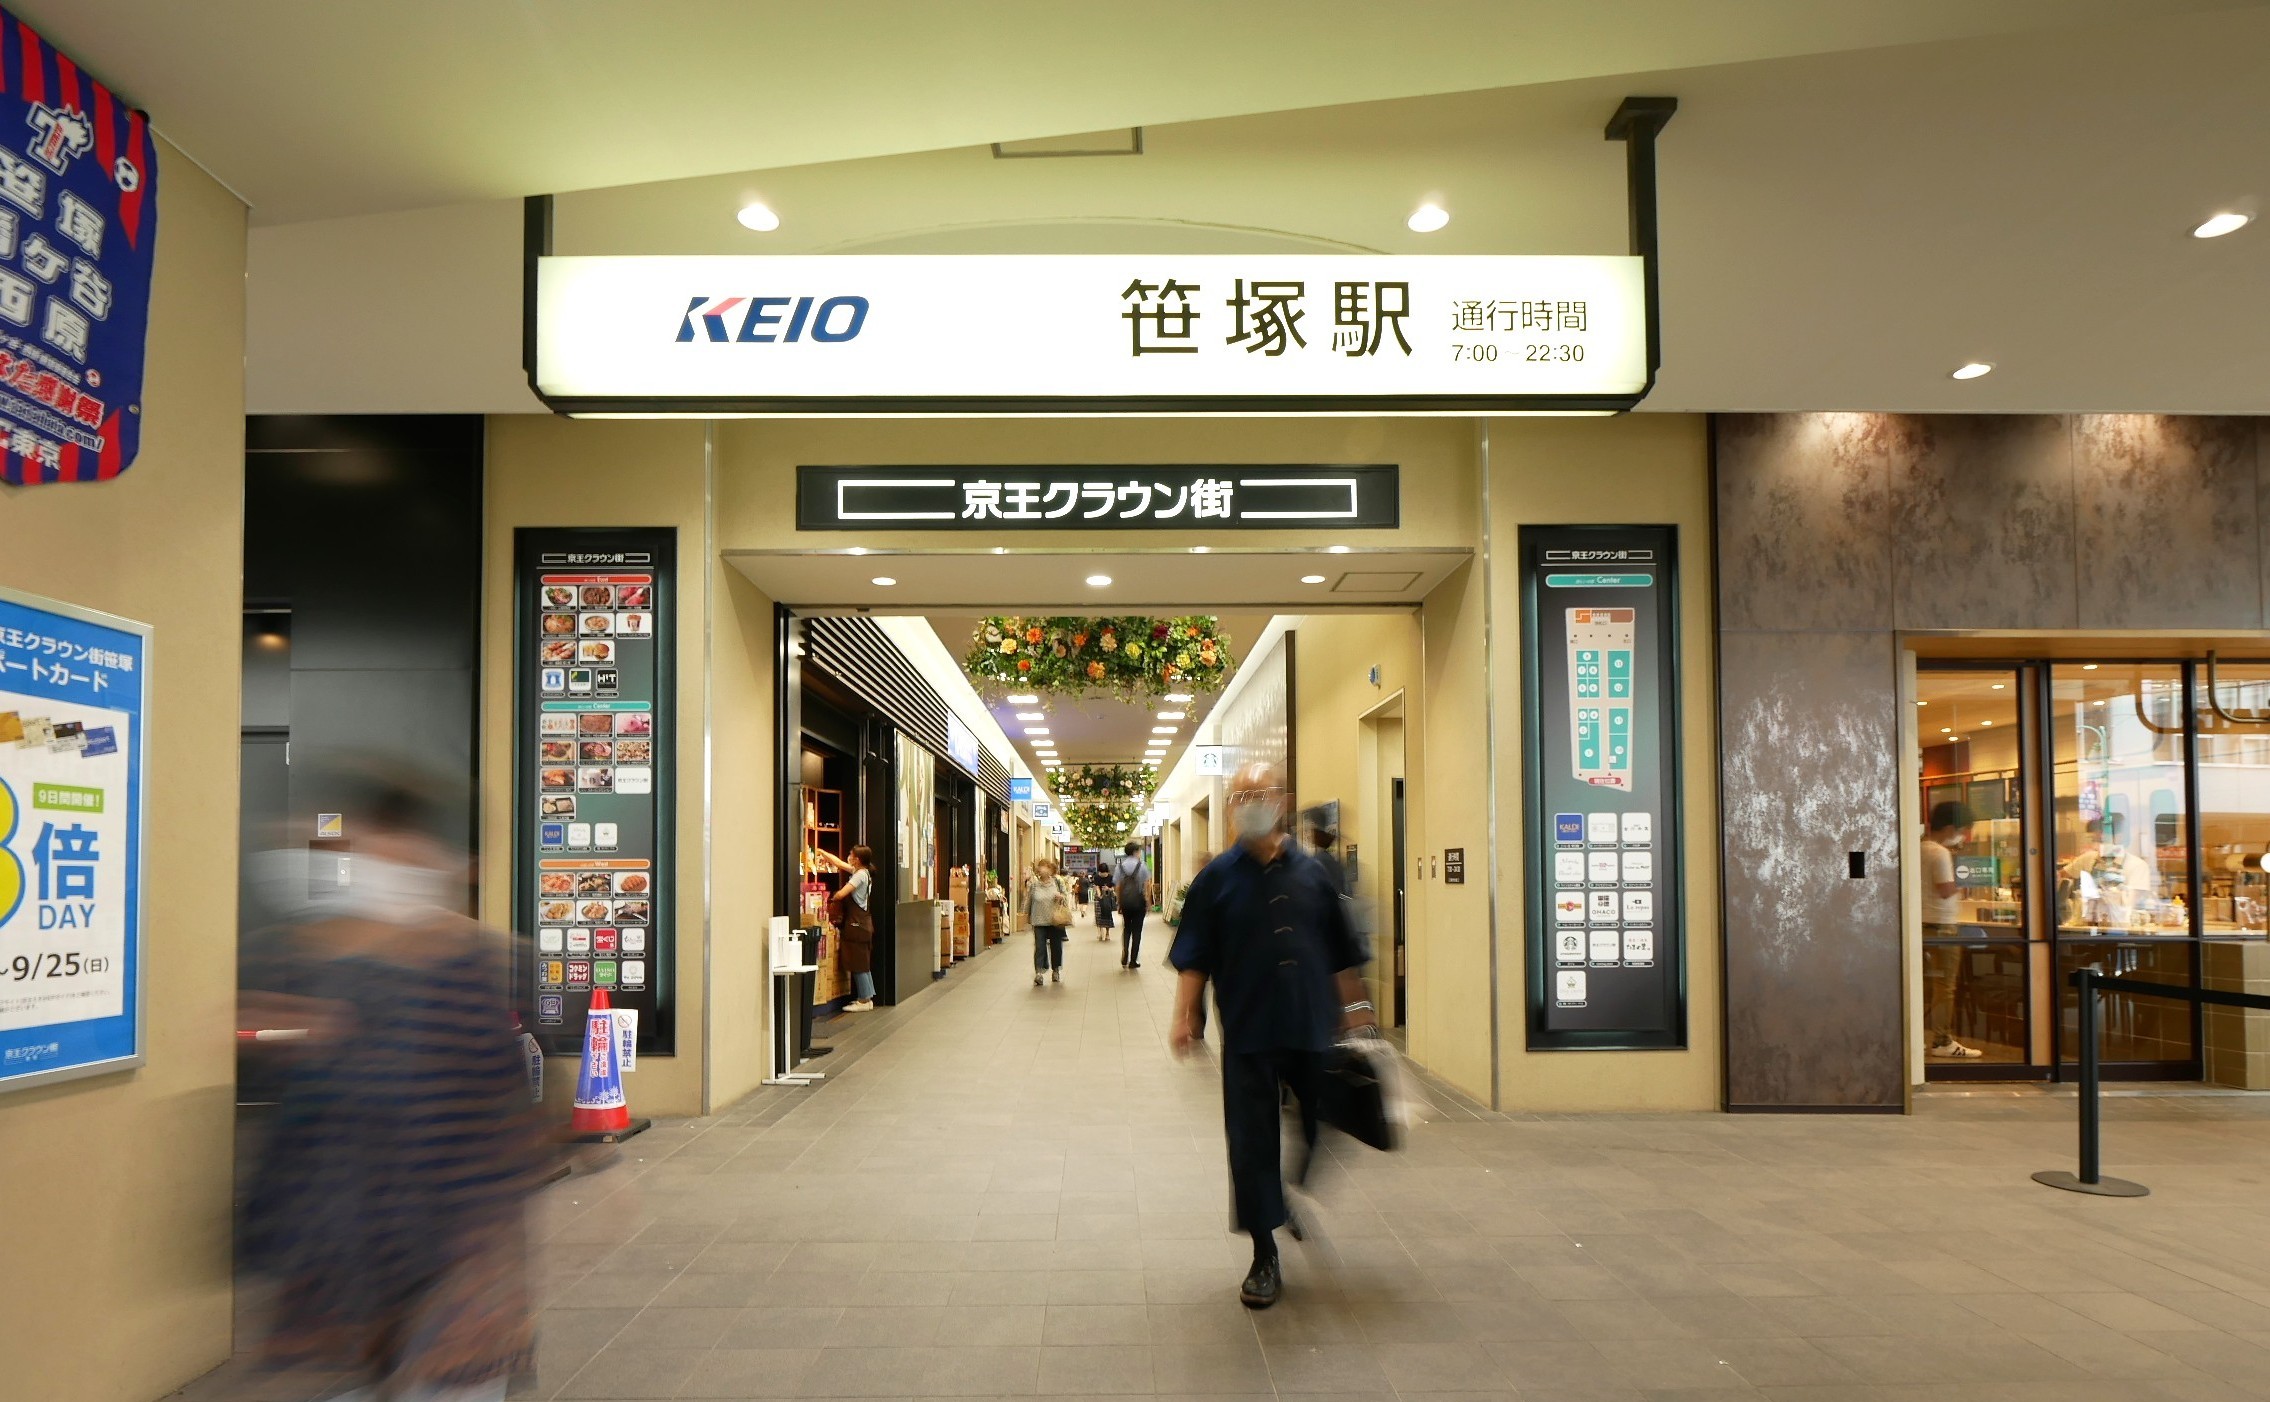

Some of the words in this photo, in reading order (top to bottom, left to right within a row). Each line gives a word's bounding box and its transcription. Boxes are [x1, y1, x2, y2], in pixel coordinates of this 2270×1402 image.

[675, 296, 870, 343] KEIO
[1121, 279, 1414, 358] 笹塚駅
[1452, 300, 1588, 332] 通行時間
[962, 479, 1234, 519] 京王クラウン街
[567, 553, 625, 564] 京王クラウン街
[1571, 550, 1628, 561] 京王クラウン街
[1596, 576, 1621, 584] Center
[0, 626, 134, 672] 王クラウン街笹塚
[38, 903, 96, 931] DAY
[621, 1029, 632, 1068] 駐輪禁止
